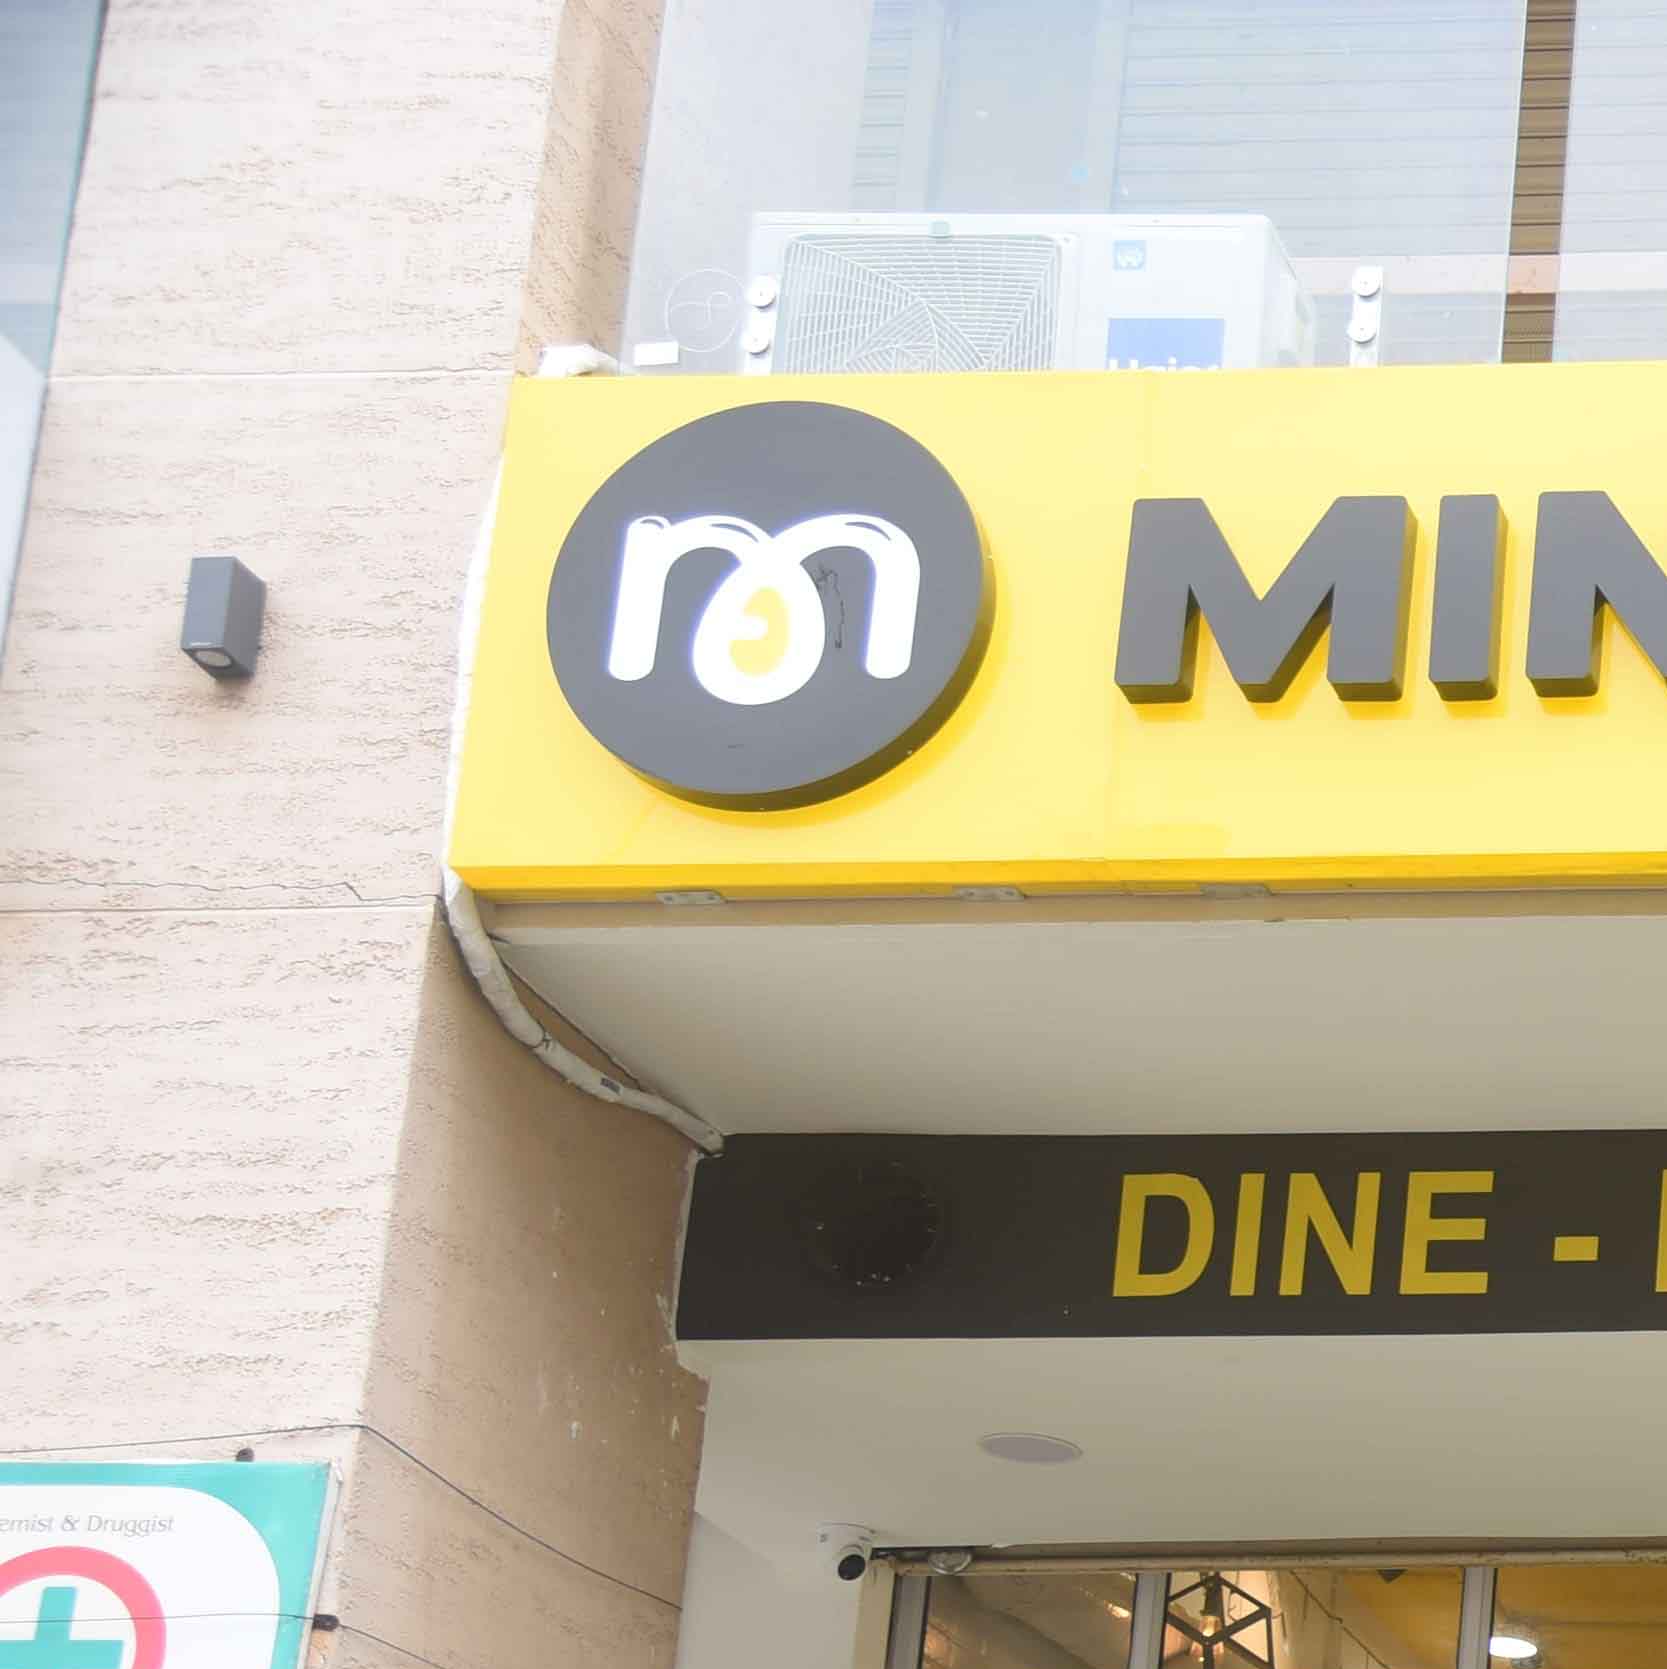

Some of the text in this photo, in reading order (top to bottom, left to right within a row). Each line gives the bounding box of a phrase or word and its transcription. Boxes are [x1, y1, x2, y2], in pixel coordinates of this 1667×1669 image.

[1112, 1171, 1494, 1297] DINE
[61, 1514, 80, 1532] &
[87, 1514, 175, 1537] Druggist
